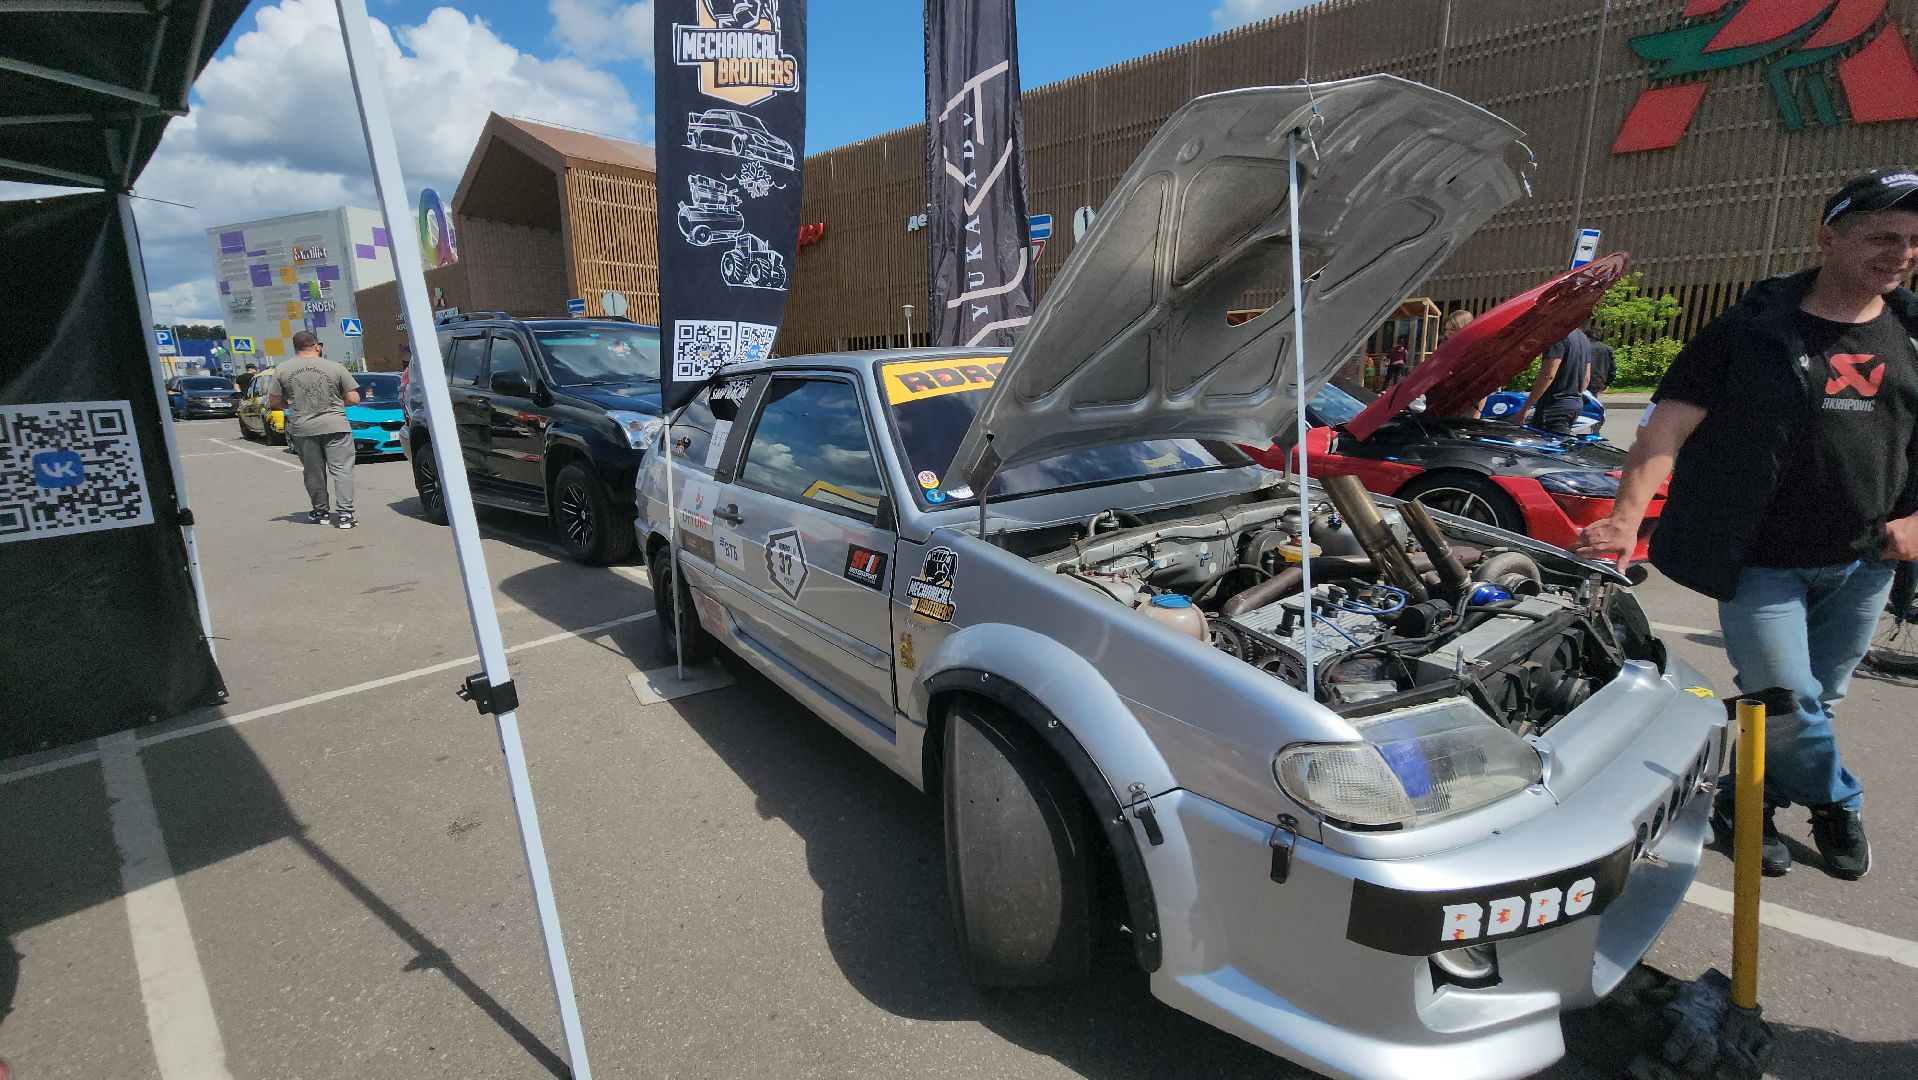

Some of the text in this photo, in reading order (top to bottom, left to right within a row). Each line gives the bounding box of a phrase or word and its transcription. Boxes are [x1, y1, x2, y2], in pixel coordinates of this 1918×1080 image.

[683, 31, 779, 60] MECHANICAL
[718, 58, 794, 86] BROTHERS
[907, 213, 928, 232] де
[41, 460, 77, 478] VK
[778, 551, 793, 576] 37
[908, 580, 952, 605] MECHANICAL
[916, 599, 953, 621] BROTHERS
